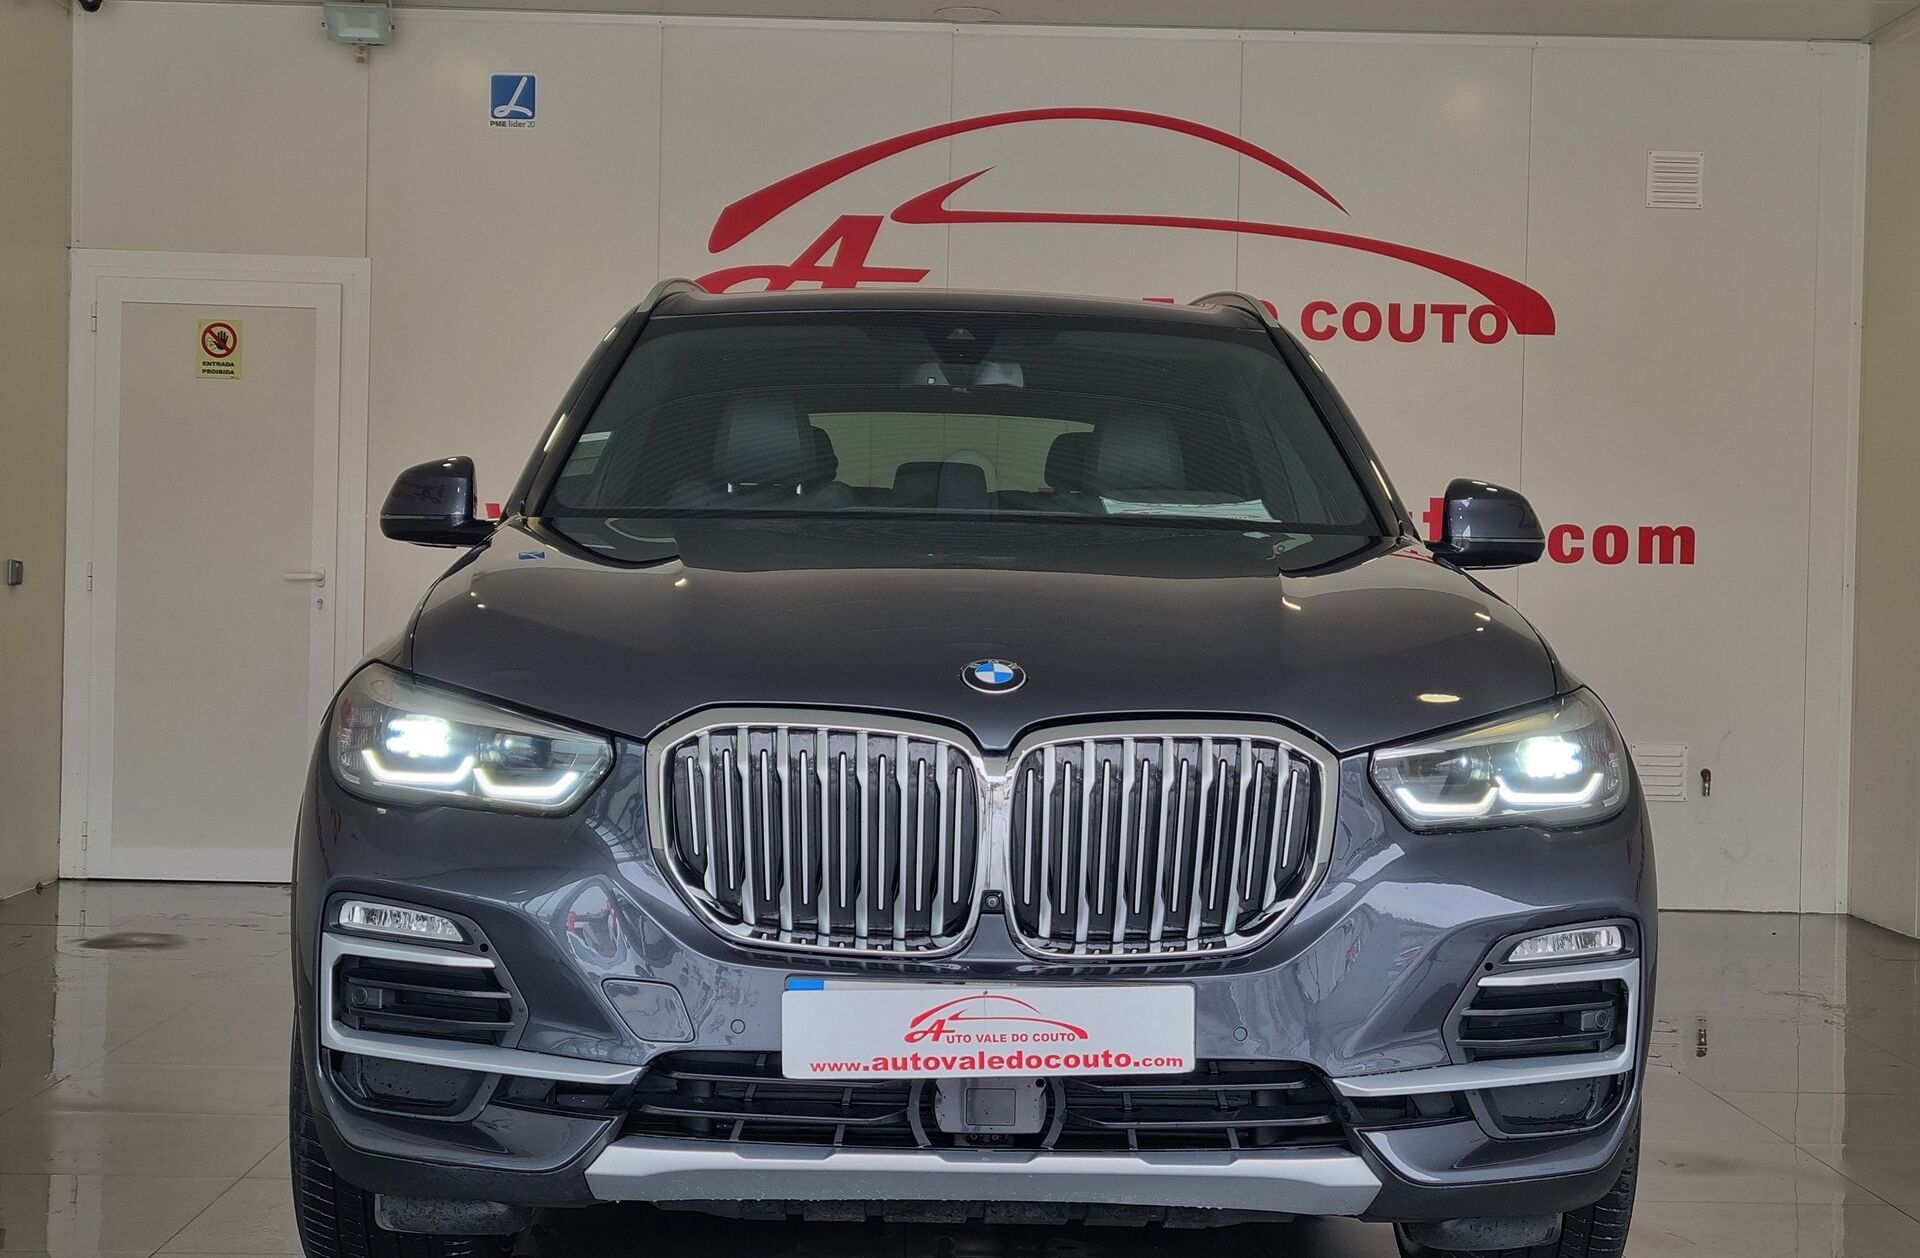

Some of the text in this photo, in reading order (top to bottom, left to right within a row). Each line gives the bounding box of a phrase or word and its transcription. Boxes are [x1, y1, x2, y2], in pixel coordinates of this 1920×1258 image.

[1301, 301, 1508, 344] COUTO
[977, 1034, 1007, 1043] VALE
[1011, 1033, 1028, 1042] DO
[1032, 1032, 1075, 1042] COUTO
[810, 1050, 1183, 1072] www.autovaledocouto.com
